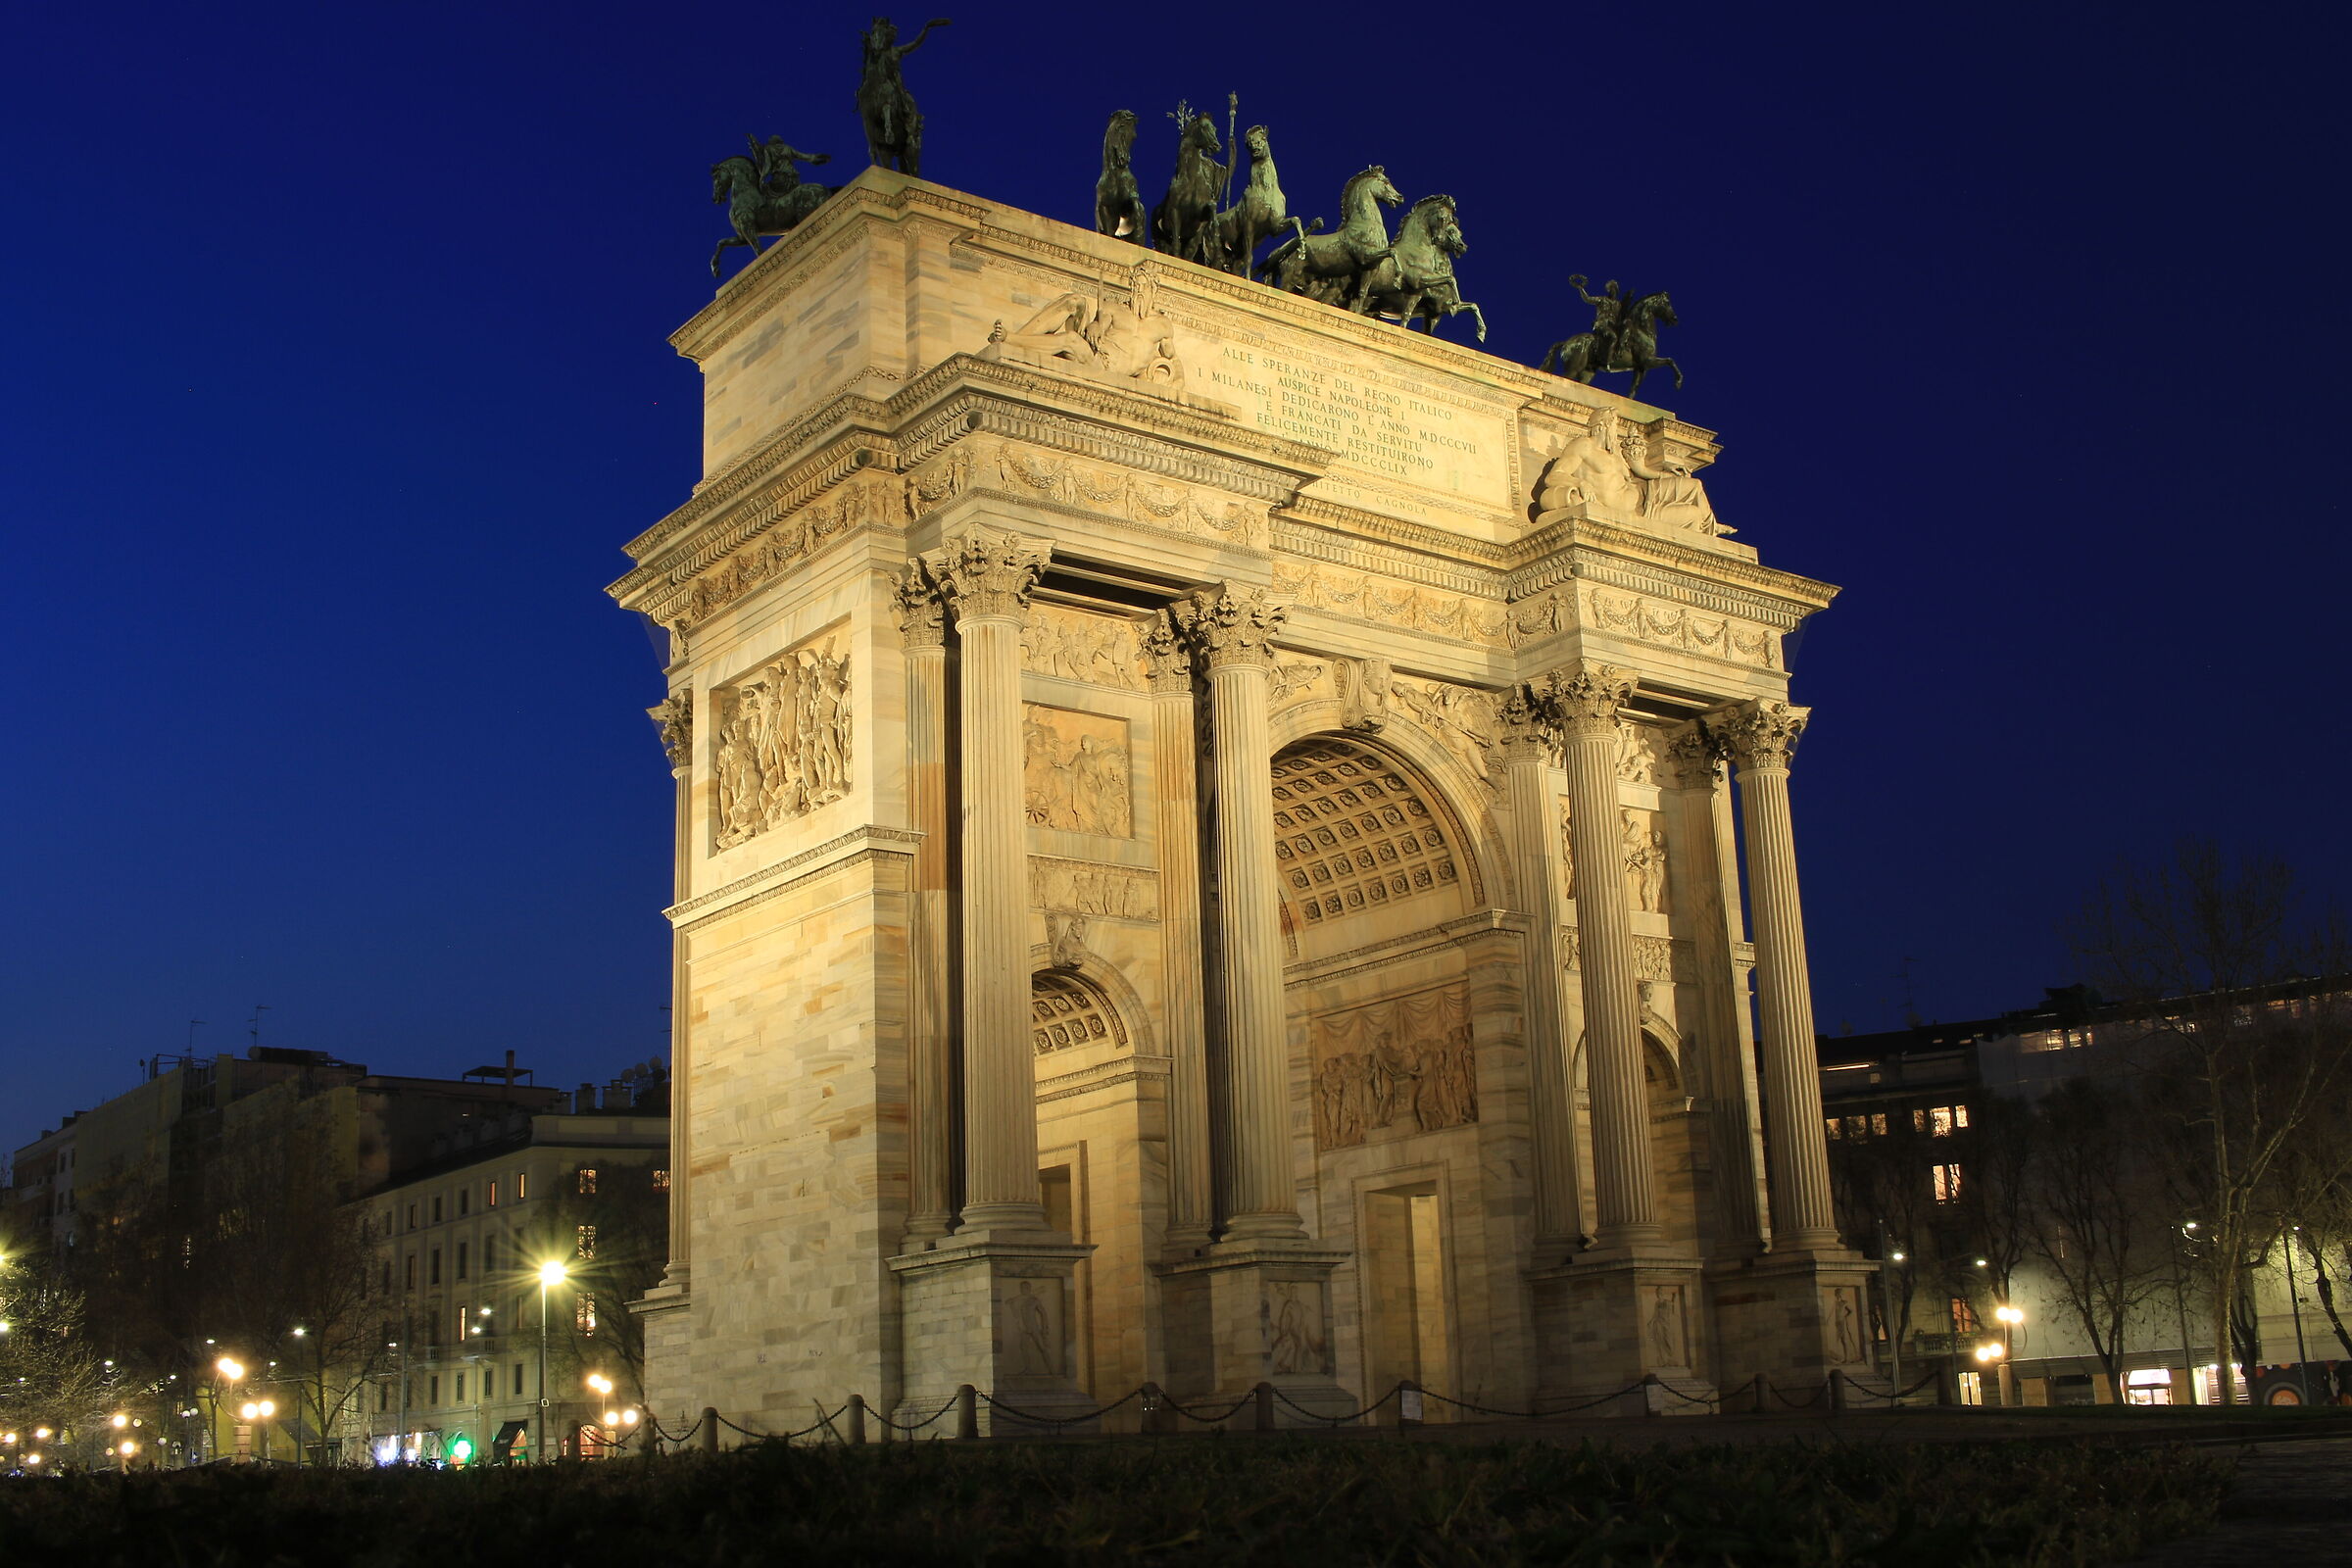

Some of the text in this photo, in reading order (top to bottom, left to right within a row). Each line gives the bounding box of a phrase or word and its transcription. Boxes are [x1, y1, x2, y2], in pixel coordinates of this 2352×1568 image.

[1223, 347, 1451, 420] ALLE SPERANZE DEL REGNO ITALICO
[1278, 376, 1321, 397] AUSPICE
[1330, 391, 1393, 417] NAPOLEONE
[1199, 368, 1202, 377] I
[1212, 371, 1272, 398] MILANESI
[1282, 391, 1359, 421] DEDICARONO
[1381, 419, 1410, 435] ANNO
[1419, 429, 1476, 455] MDCCCVII
[1266, 401, 1422, 453] E FRANCATI DA SERVITU
[1257, 412, 1434, 469] FELICEMENTE RESTITUIRONO
[1342, 449, 1407, 475] MDCCCLIX
[1376, 495, 1427, 516] CAGNOLA
